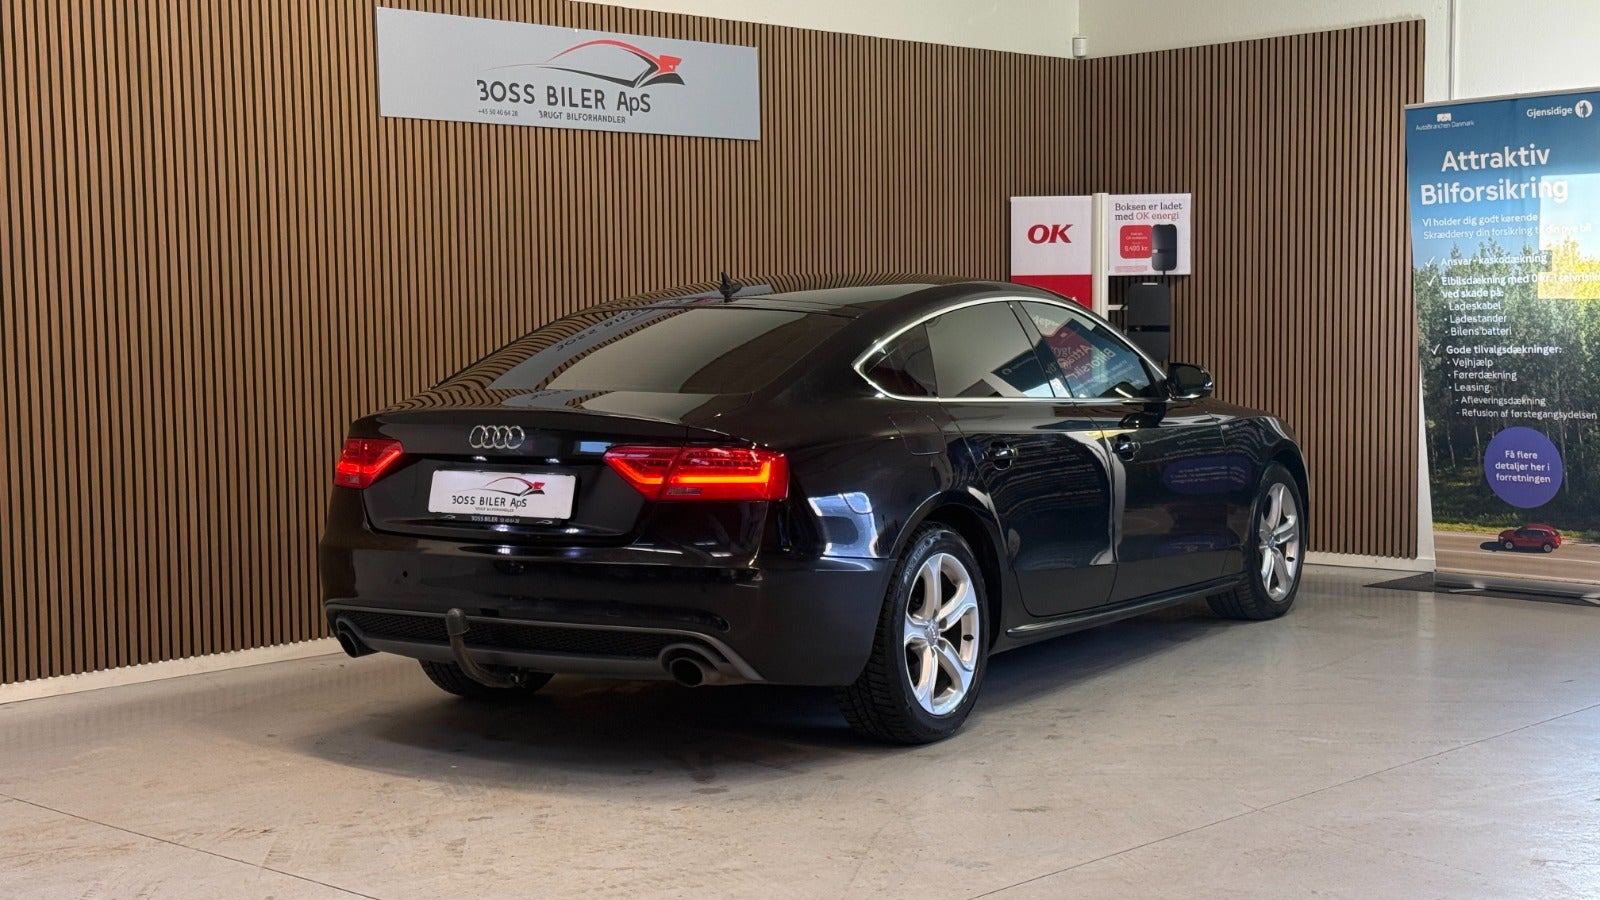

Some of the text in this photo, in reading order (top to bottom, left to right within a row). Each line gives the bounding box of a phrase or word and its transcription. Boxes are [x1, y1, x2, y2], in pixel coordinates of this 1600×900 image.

[547, 86, 605, 110] BILER
[617, 91, 651, 116] ApS
[566, 112, 626, 124] BILFORHANDLER
[1526, 107, 1572, 119] Gjensidige
[1441, 144, 1550, 172] Attraktiv
[1421, 176, 1568, 205] Bilforsikring
[1115, 202, 1146, 211] Boksen
[1160, 202, 1183, 210] ladet
[1152, 212, 1179, 221] energi
[1422, 214, 1538, 226] Vi holder dig godt kørende
[1028, 224, 1073, 244] OK
[1423, 229, 1473, 240] Skræddersy
[1476, 228, 1490, 237] din
[1491, 226, 1532, 237] forsikring
[1478, 254, 1548, 266] kaskodækning
[1442, 276, 1506, 286] Elbilsdækning
[1508, 274, 1530, 284] med
[1532, 274, 1538, 283] 0
[1443, 290, 1459, 299] ved
[1460, 289, 1488, 298] skade
[1450, 302, 1500, 311] Ladeskabel
[1450, 314, 1507, 323] Ladestander
[1451, 327, 1512, 336] Bilens batteri
[1446, 344, 1562, 356] Gode tilvalgsdækninger:
[1452, 358, 1494, 368] Vejhjælp
[1454, 370, 1517, 381] Førerdækning
[1461, 396, 1546, 406] Afleveringsdækning
[1462, 409, 1598, 420] Refusion af førstegangsydelsen
[1505, 450, 1538, 459] Få flere
[1495, 462, 1528, 472] detaljer
[1530, 463, 1545, 471] her
[1496, 474, 1551, 484] forretningen
[479, 496, 506, 507] BILER
[510, 498, 527, 509] ApS
